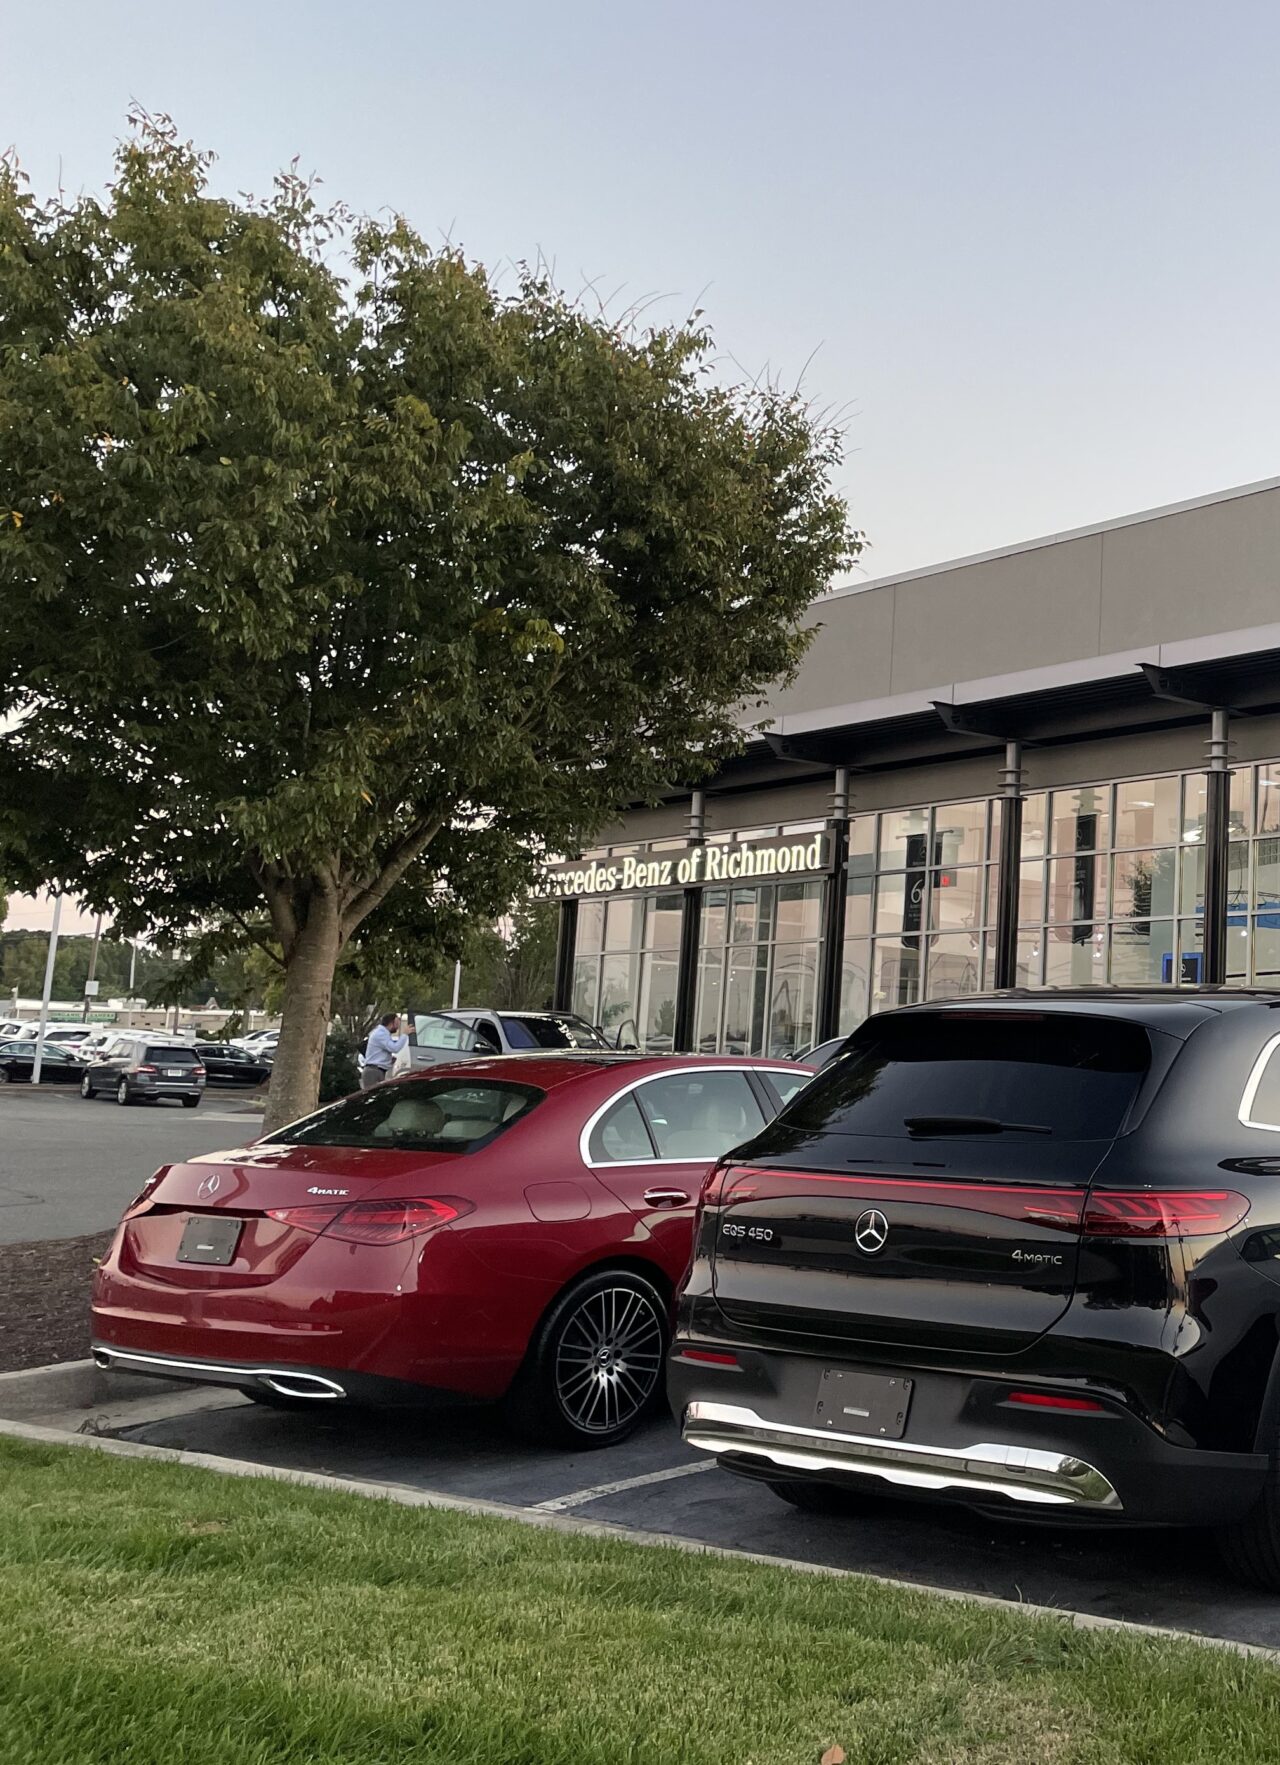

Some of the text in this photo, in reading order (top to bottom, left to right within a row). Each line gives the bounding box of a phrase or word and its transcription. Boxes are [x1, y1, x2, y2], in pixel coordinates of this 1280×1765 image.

[677, 848, 700, 884] of
[703, 834, 821, 880] Richmond
[307, 1186, 350, 1196] 4MATIC
[722, 1223, 773, 1241] EQS 450
[1011, 1250, 1063, 1265] 4MATIC
